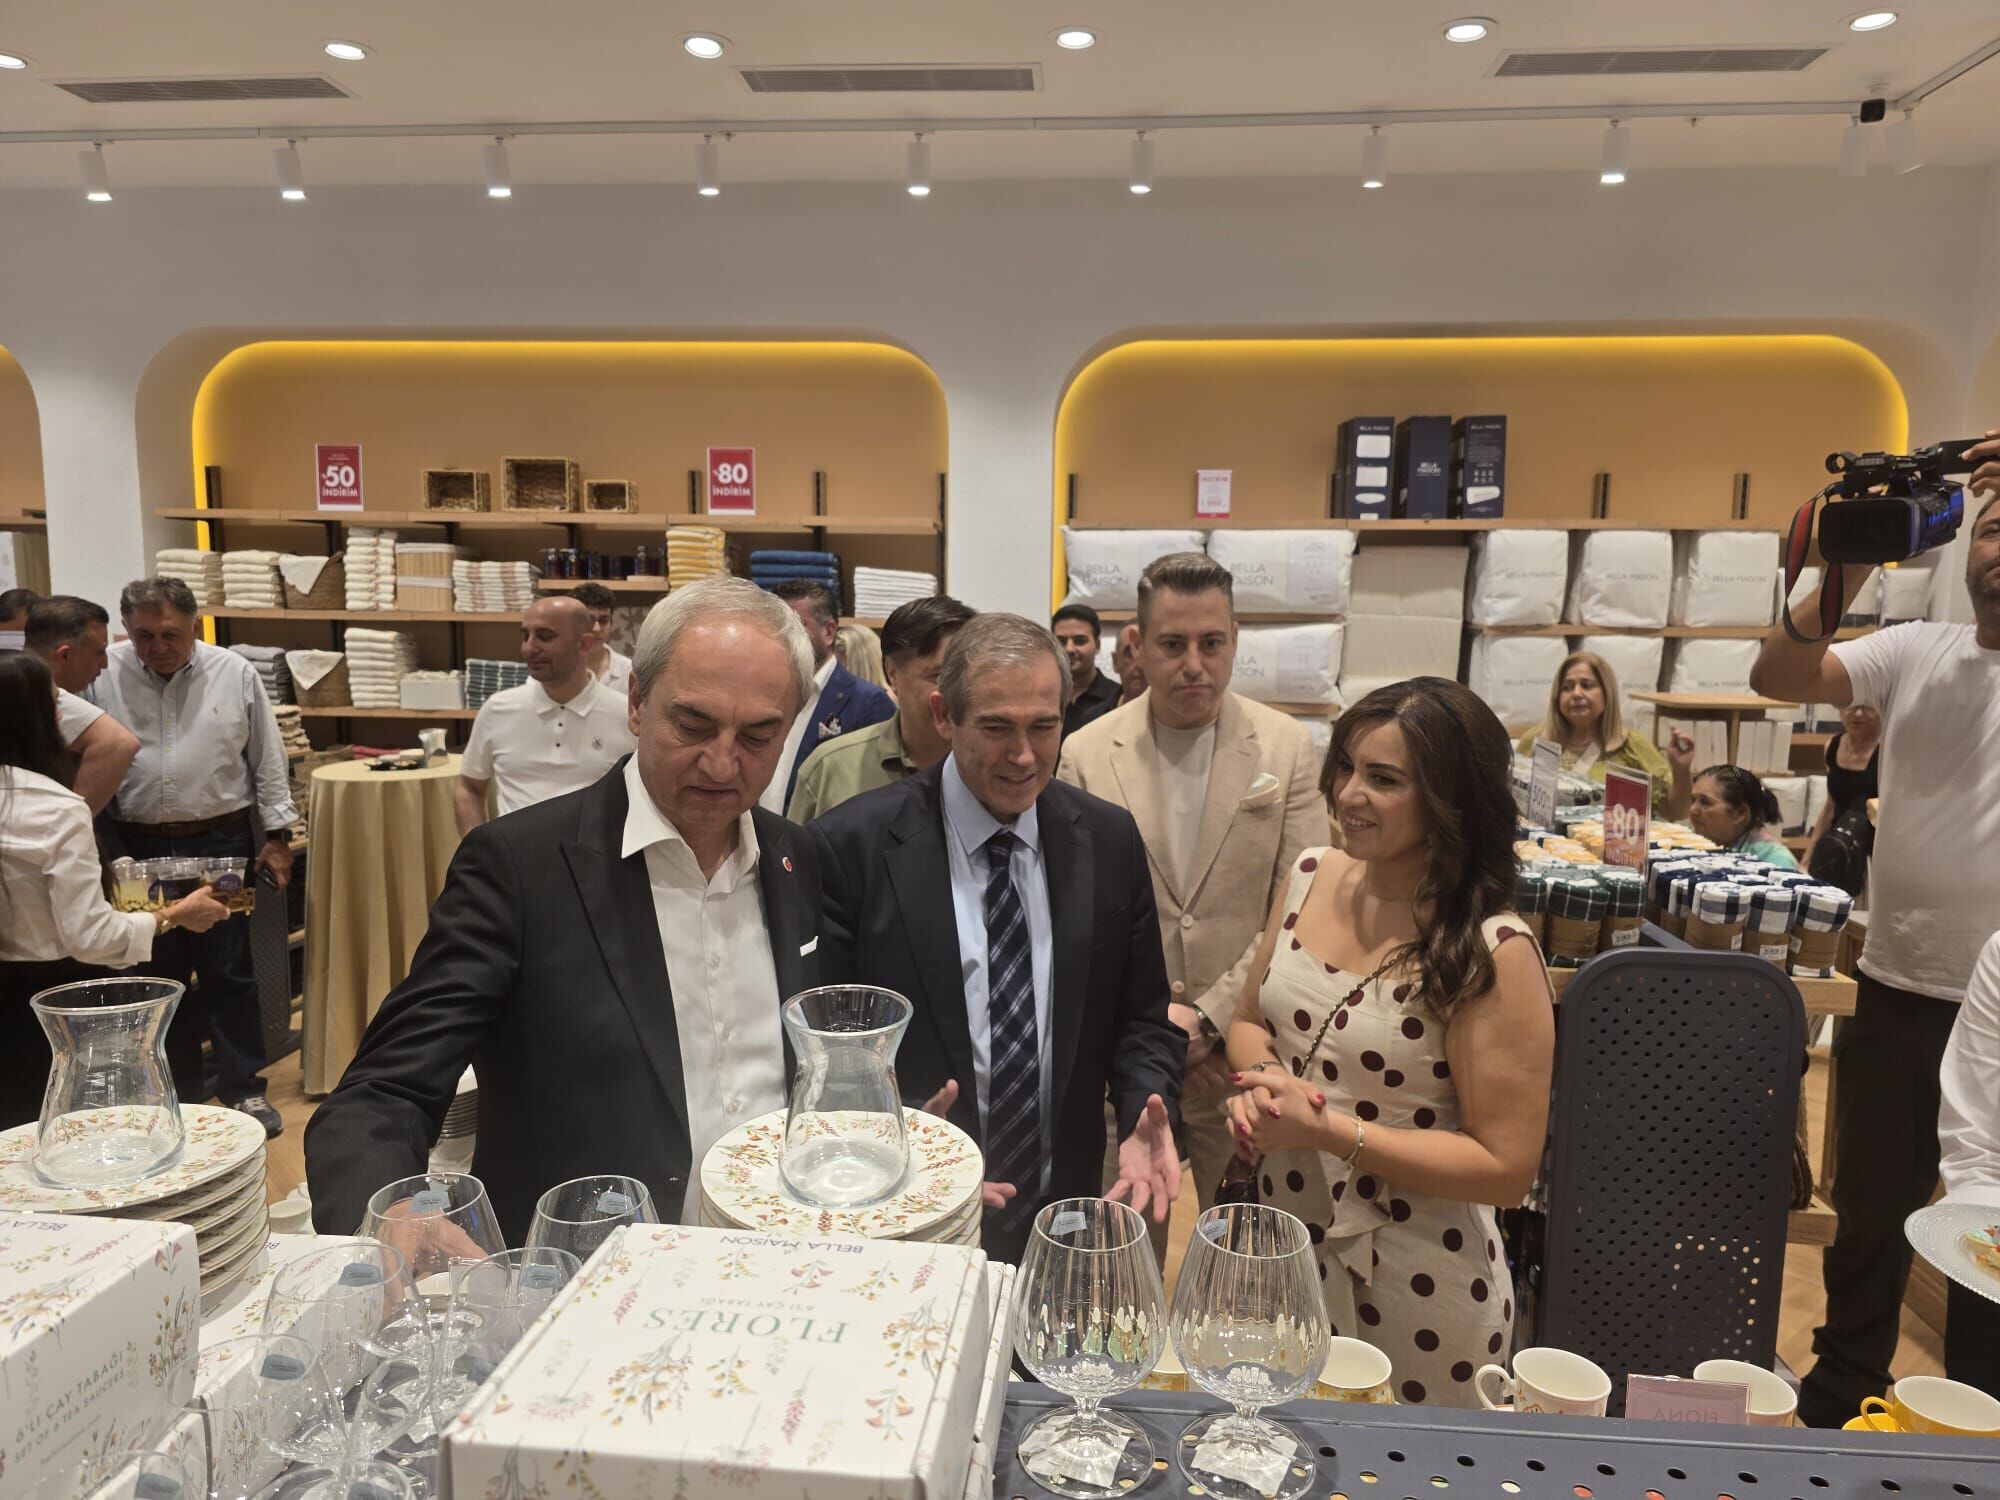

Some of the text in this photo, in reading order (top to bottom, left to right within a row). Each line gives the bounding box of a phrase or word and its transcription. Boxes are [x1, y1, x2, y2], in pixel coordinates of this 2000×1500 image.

[1086, 564, 1121, 575] BELLA
[1232, 574, 1275, 586] AISON
[1235, 655, 1256, 665] LLA
[720, 1235, 864, 1254] BELLA MAISON
[642, 1307, 849, 1344] FLORES
